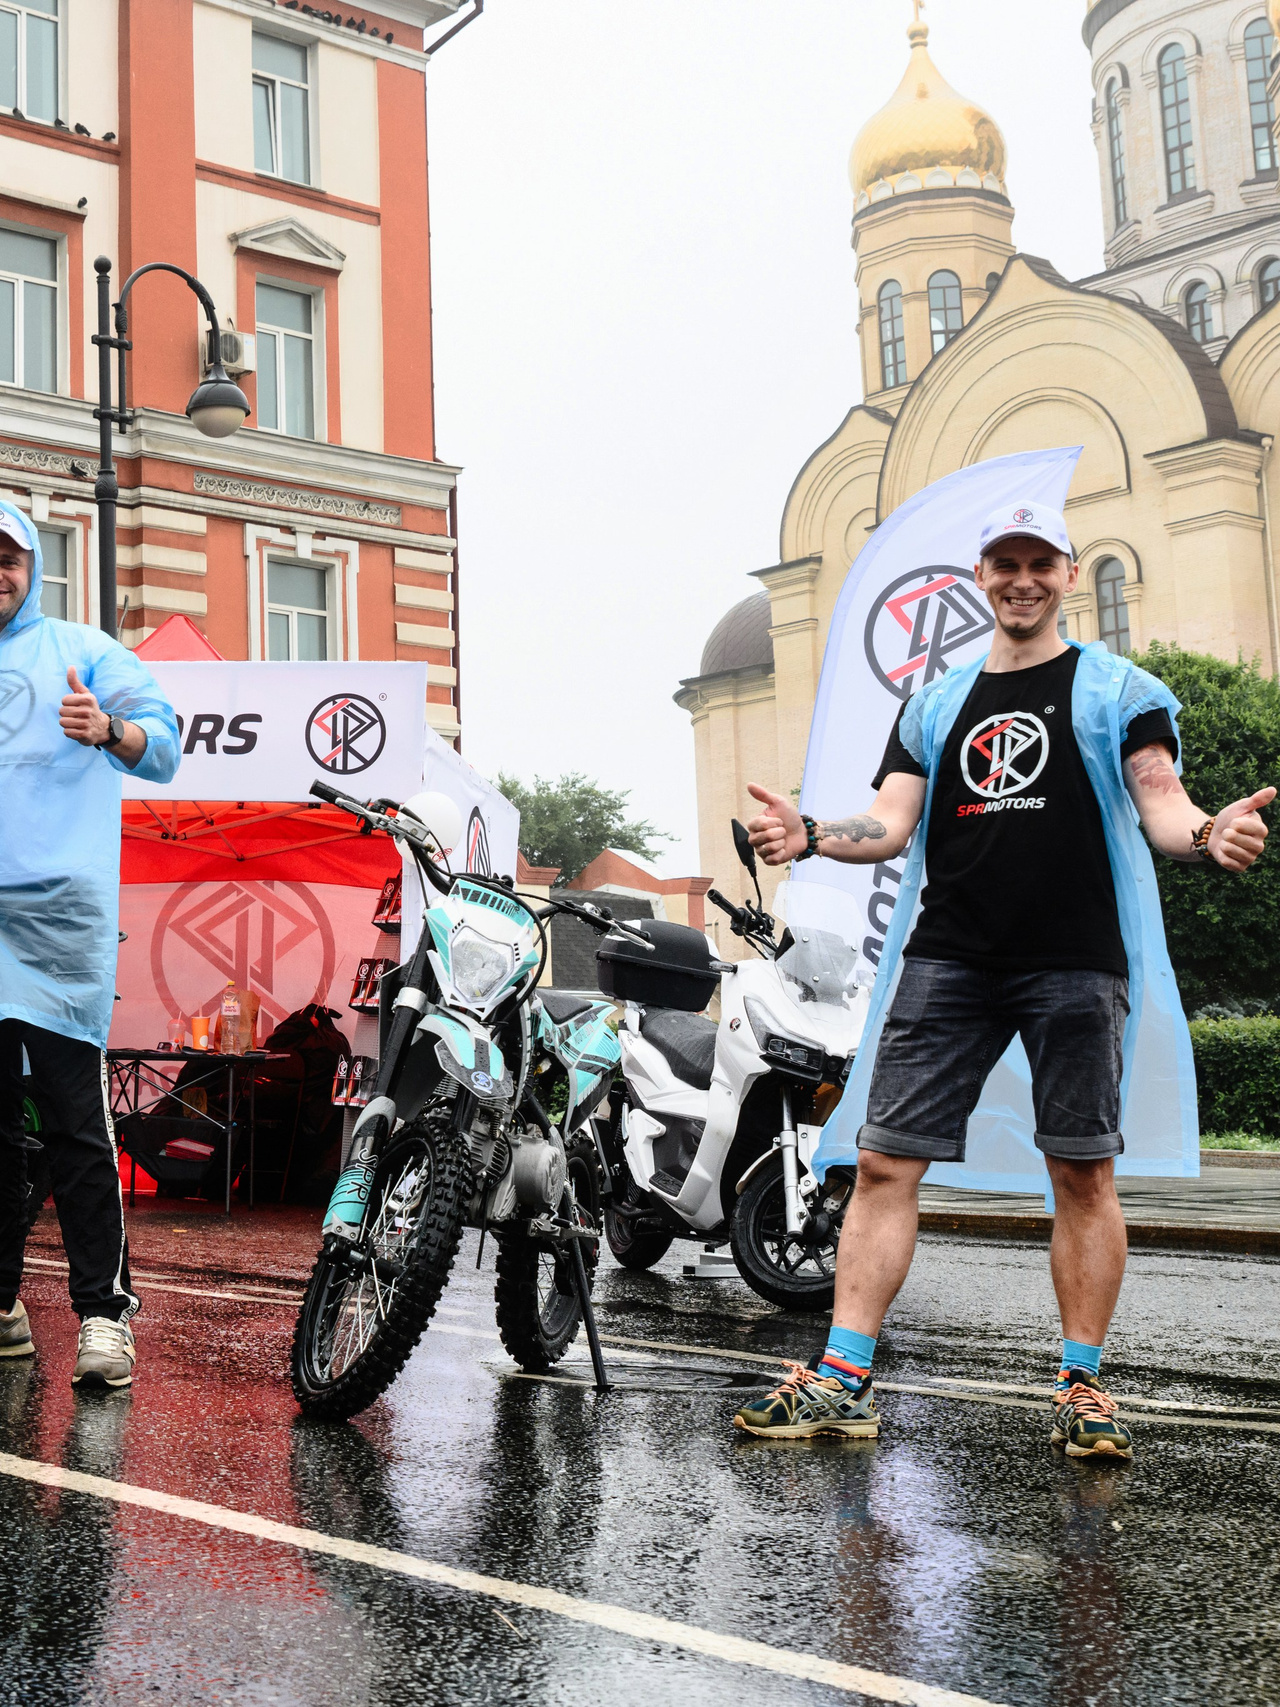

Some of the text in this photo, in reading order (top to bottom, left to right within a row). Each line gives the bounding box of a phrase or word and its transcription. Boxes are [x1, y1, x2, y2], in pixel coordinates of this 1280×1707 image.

[176, 713, 263, 755] RS
[956, 797, 1047, 817] SPRMOTORS
[347, 1147, 379, 1202] SPR
